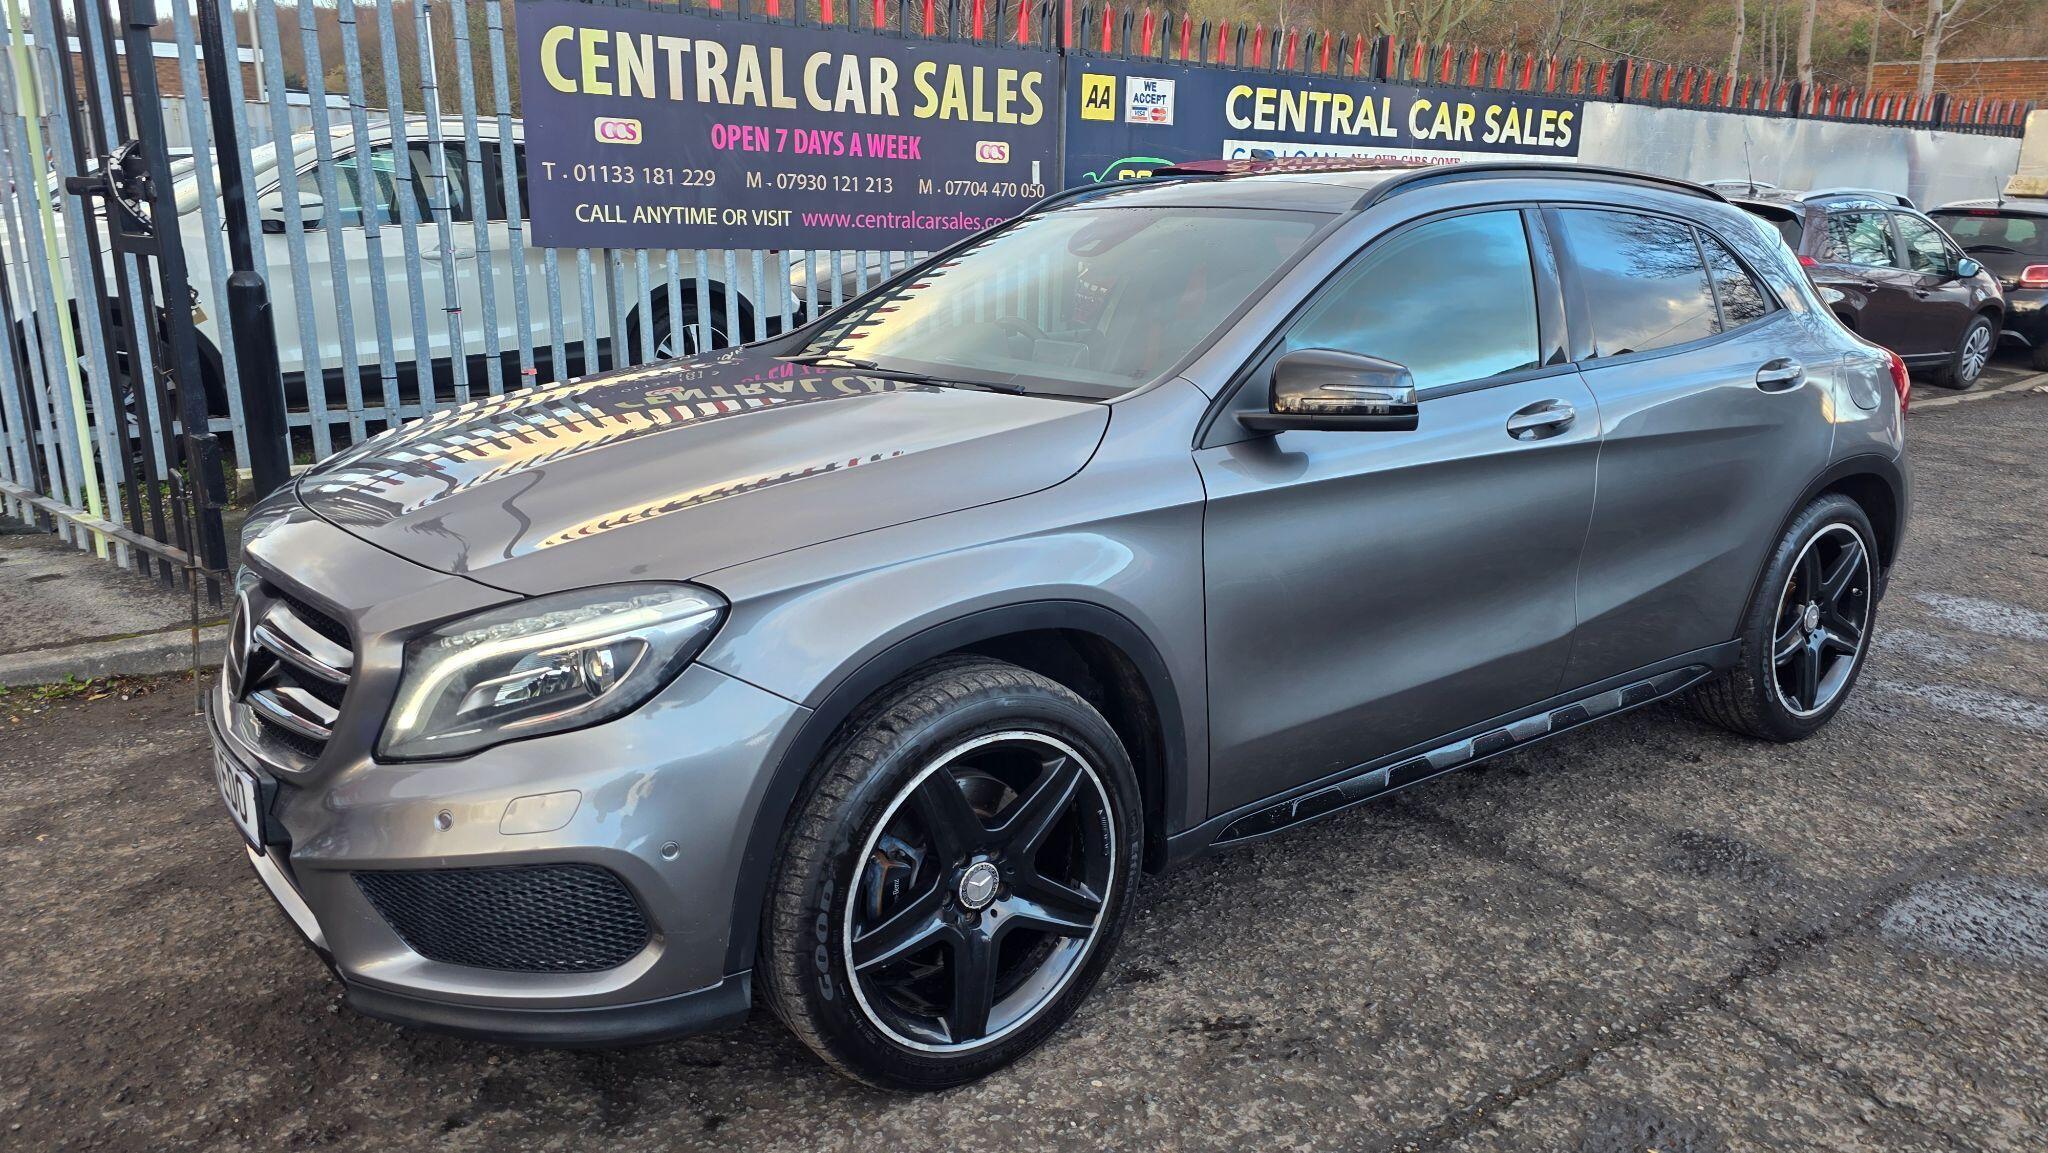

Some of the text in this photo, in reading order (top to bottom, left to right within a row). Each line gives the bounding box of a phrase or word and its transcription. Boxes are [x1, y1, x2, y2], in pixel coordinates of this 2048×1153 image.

[540, 25, 1044, 126] CENTRAL CAR SALES
[1143, 80, 1157, 92] WE
[1085, 84, 1111, 110] AA
[1132, 92, 1167, 105] ACCEPT
[1225, 84, 1574, 148] CENTRAL CAR SALES
[711, 123, 922, 160] OPEN 7 DAYS A WEEK
[573, 163, 635, 184] 01133
[642, 167, 674, 185] 181
[682, 168, 716, 187] 229
[776, 173, 827, 191] 07930
[833, 175, 859, 192] 121
[865, 176, 893, 193] 213
[945, 180, 988, 197] 07704
[992, 183, 1016, 198] 470
[1020, 183, 1045, 198] 050
[575, 203, 792, 227] CALL ANYTIME OR VISIT
[802, 210, 1010, 231] www.centralcarsales.co
